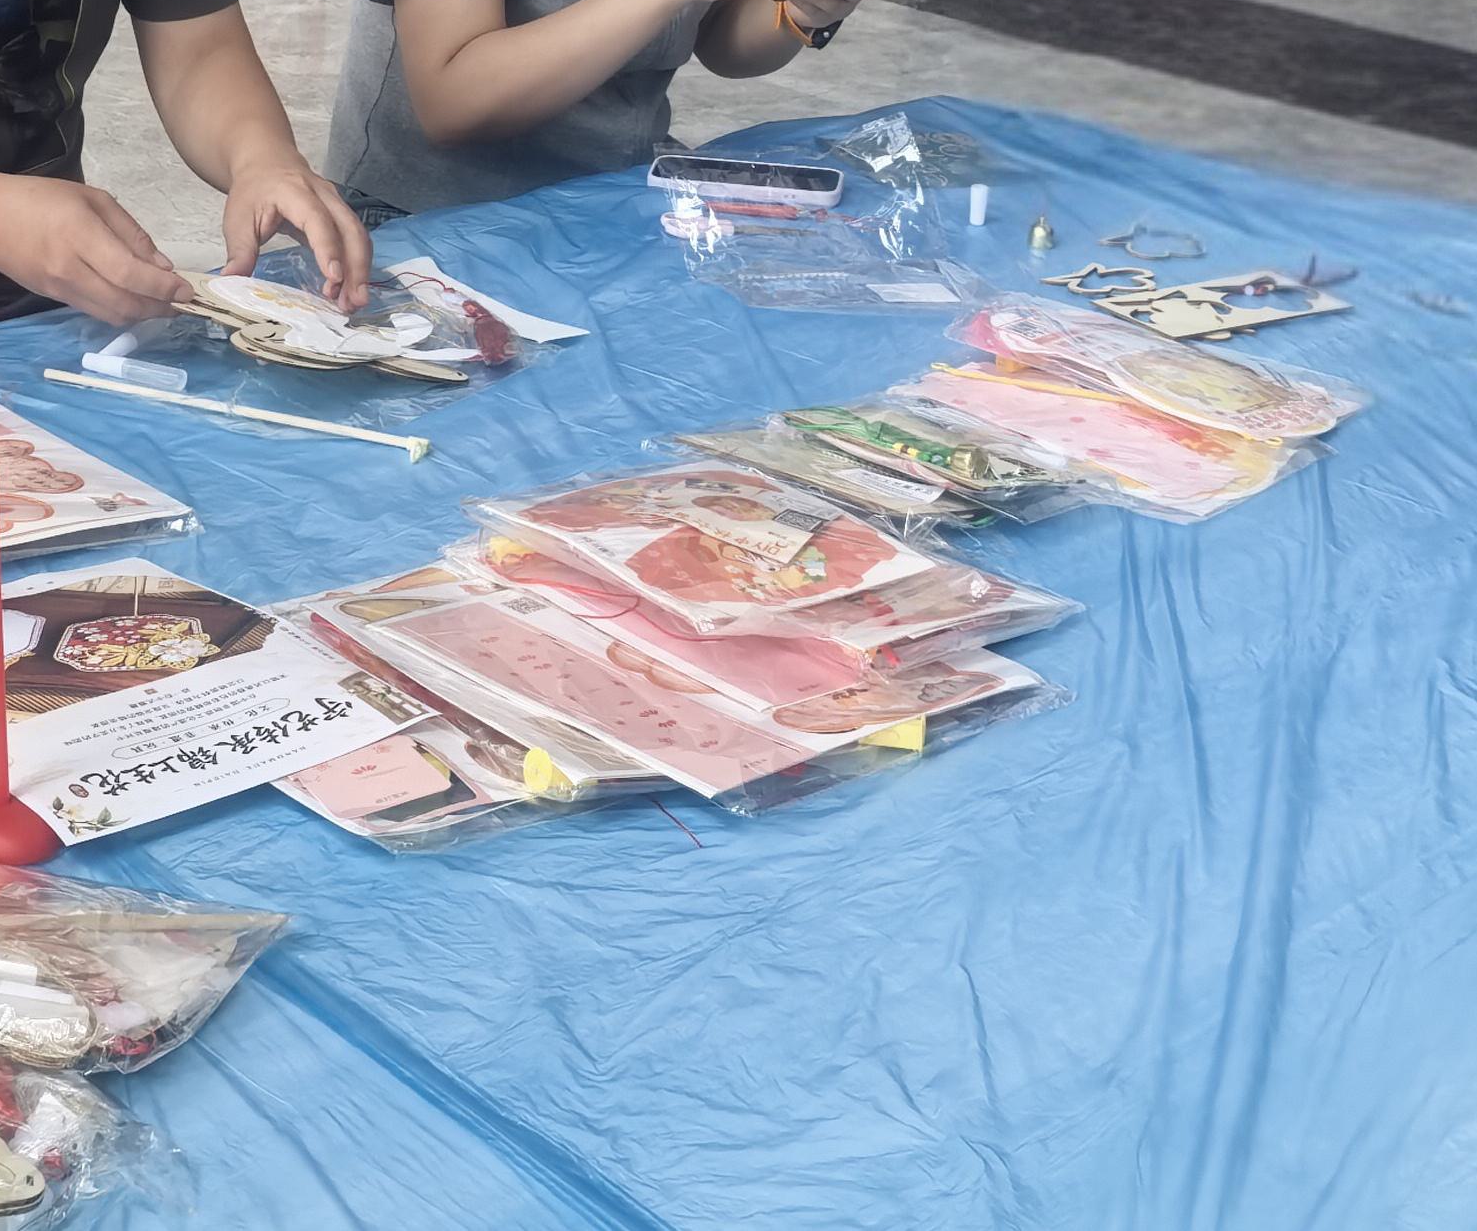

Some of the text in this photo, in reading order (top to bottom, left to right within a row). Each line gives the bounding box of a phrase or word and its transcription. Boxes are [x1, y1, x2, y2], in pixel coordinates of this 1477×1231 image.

[79, 697, 353, 797] 守艺传承 锦上生花
